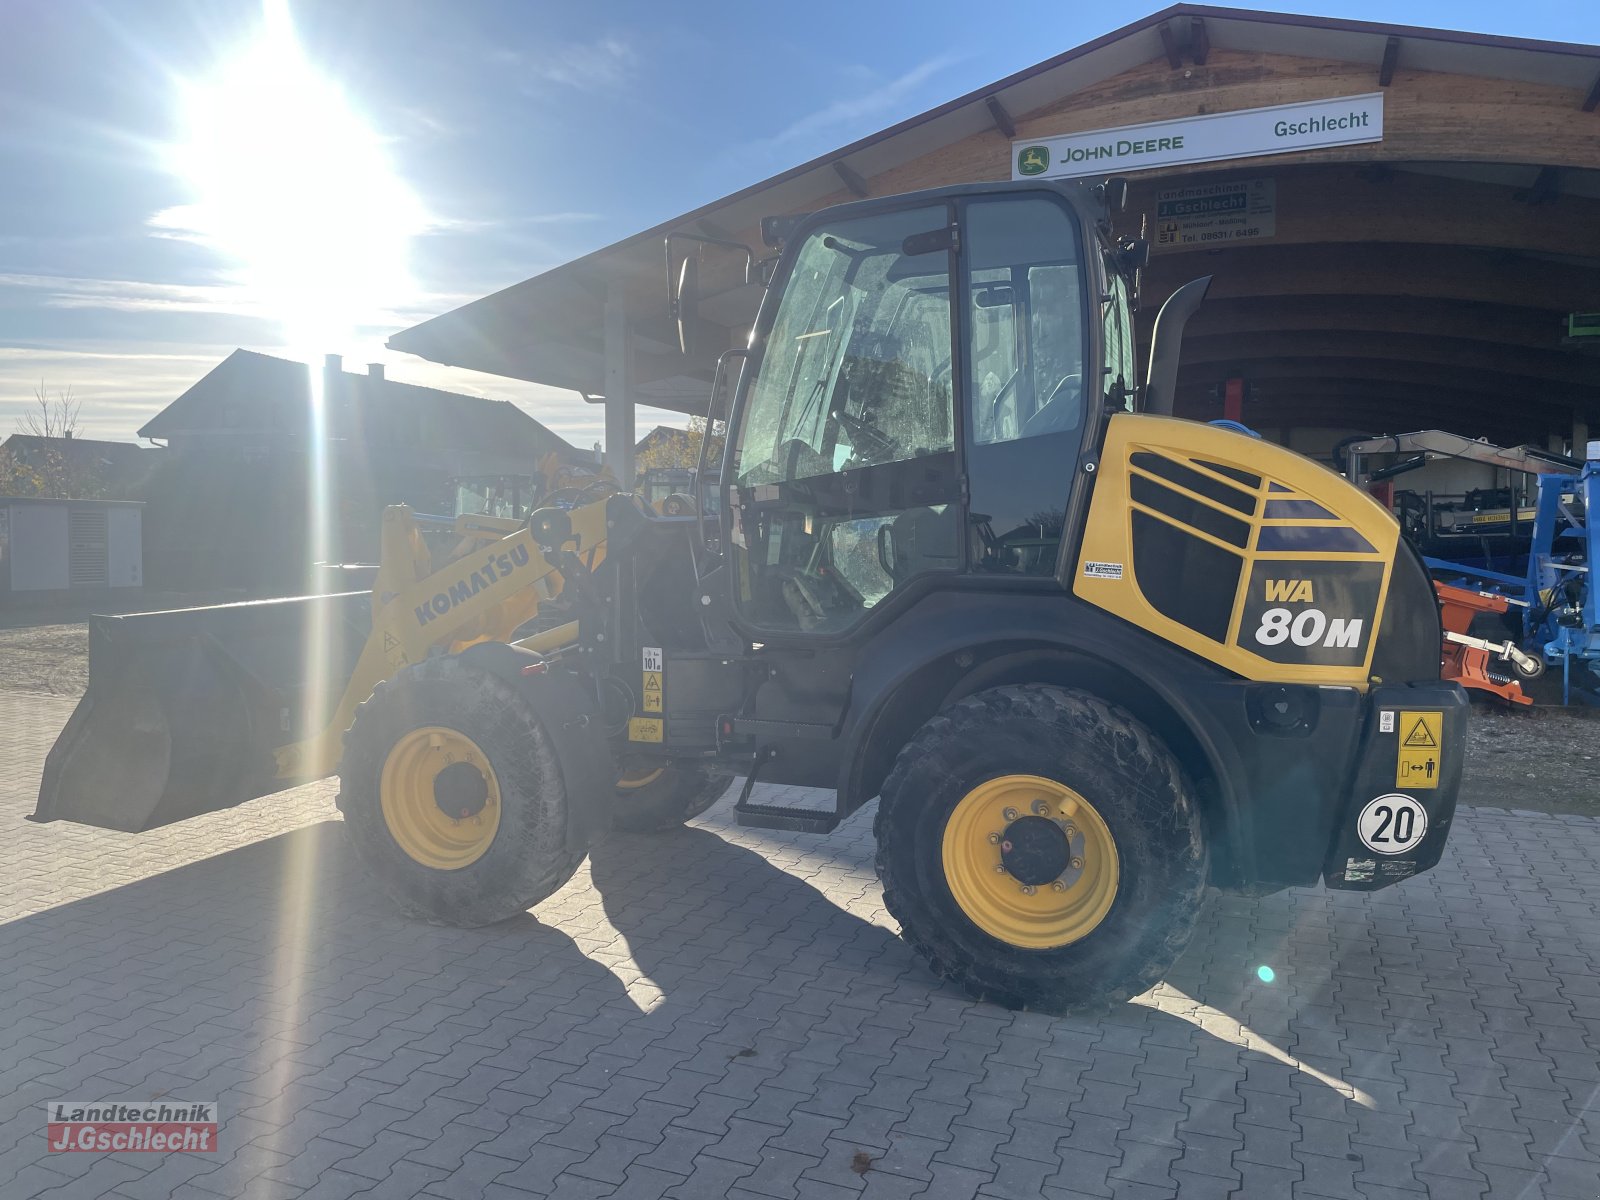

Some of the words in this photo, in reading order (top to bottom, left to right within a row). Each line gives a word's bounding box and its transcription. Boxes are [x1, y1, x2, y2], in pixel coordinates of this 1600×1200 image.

[1274, 111, 1369, 137] Gschlecht
[1060, 145, 1112, 163] JOHN
[1117, 136, 1184, 157] DEERE
[1158, 183, 1248, 200] Landmaschinen
[1175, 196, 1244, 214] Gschlecht
[1183, 234, 1198, 243] Tel.
[414, 543, 529, 626] KOMATSU
[1265, 579, 1314, 603] WA
[1255, 607, 1363, 648] 80M
[644, 657, 656, 670] 101
[1370, 805, 1415, 844] 20
